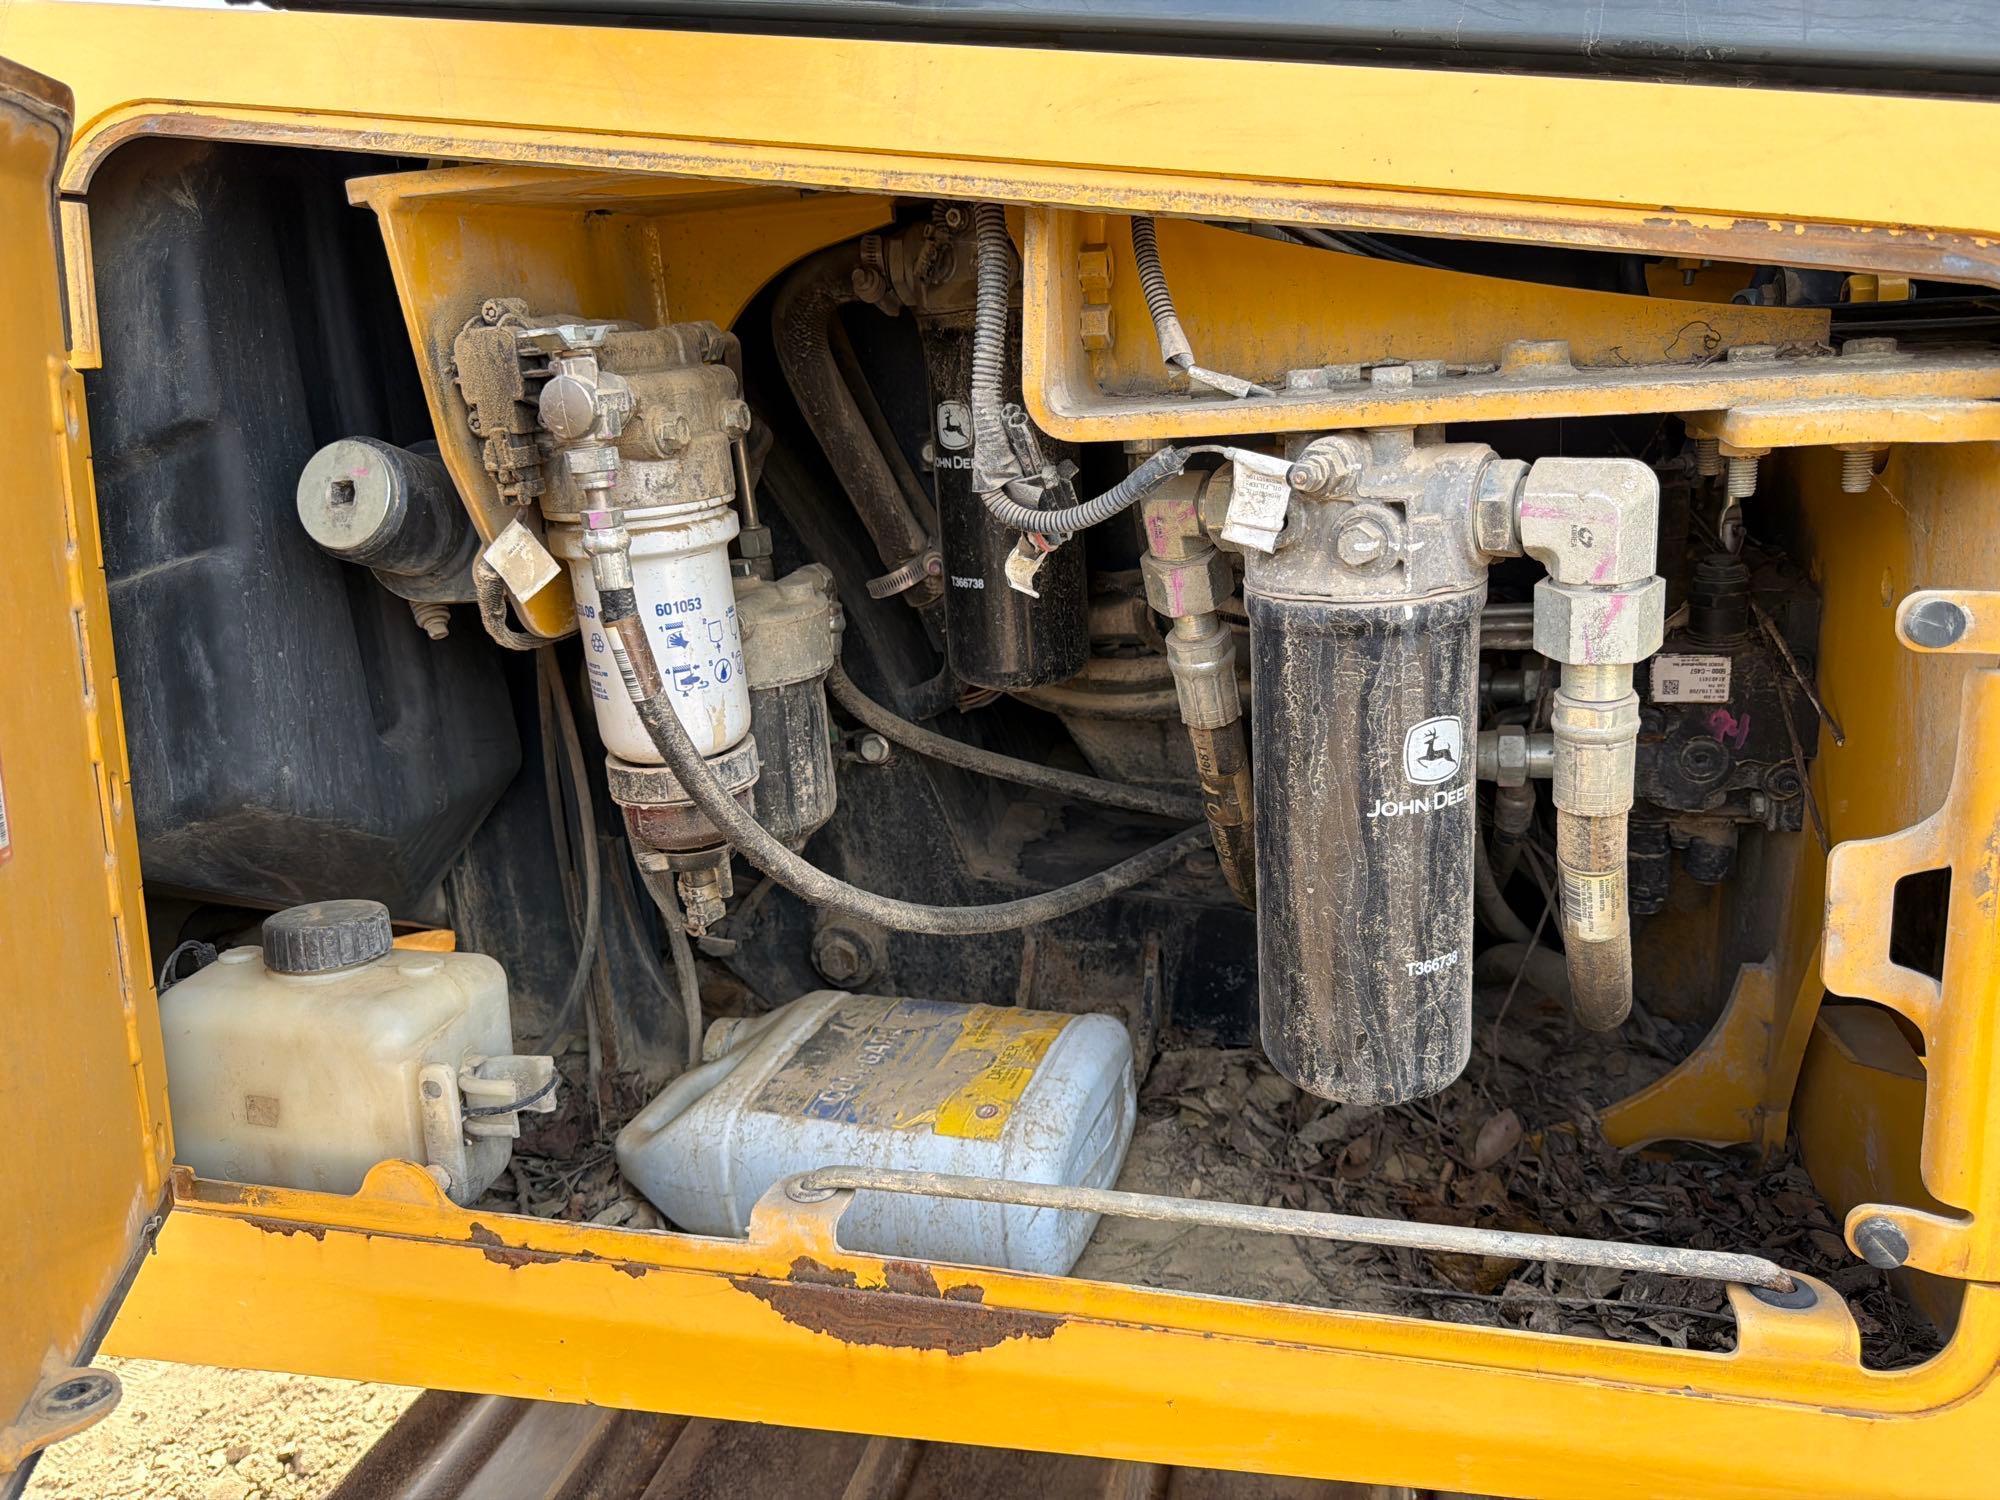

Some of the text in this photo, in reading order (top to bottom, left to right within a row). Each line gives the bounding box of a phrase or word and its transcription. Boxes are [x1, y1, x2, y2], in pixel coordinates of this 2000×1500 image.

[934, 456, 952, 469] OHN
[655, 597, 702, 617] 601053
[1366, 797, 1430, 818] JOHN
[1405, 950, 1458, 977] T366738
